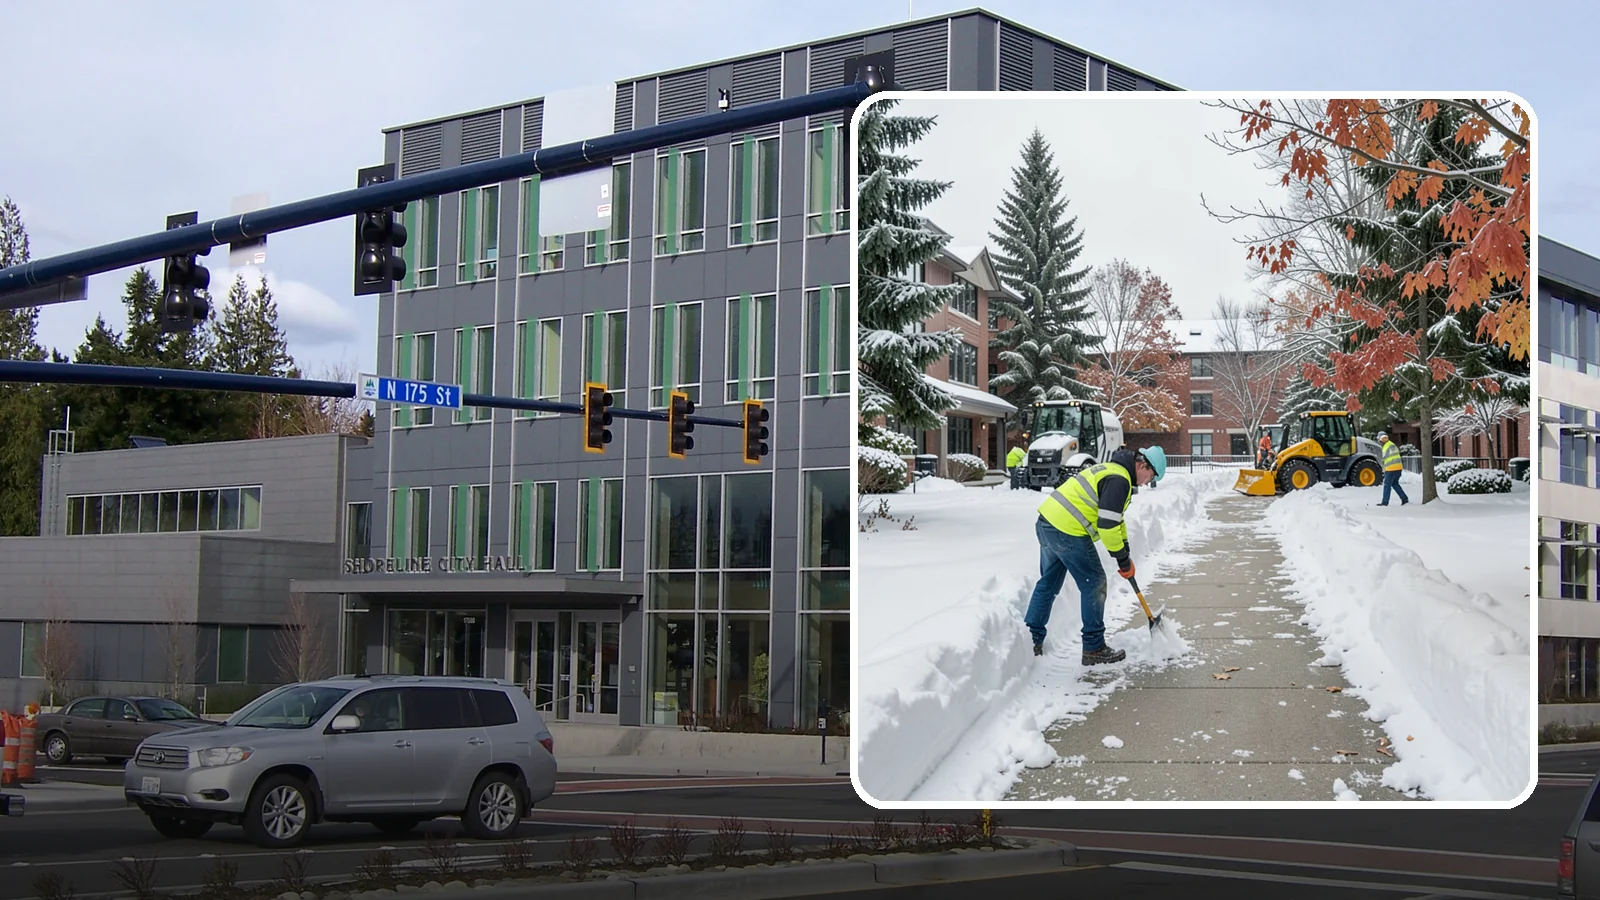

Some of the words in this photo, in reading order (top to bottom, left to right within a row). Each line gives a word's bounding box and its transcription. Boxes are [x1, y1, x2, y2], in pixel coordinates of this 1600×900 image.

[387, 380, 396, 399] N
[405, 382, 427, 403] 175
[436, 386, 451, 405] St
[344, 557, 431, 573] SHORELINE
[438, 556, 475, 572] CITY
[484, 556, 525, 571] HALL
